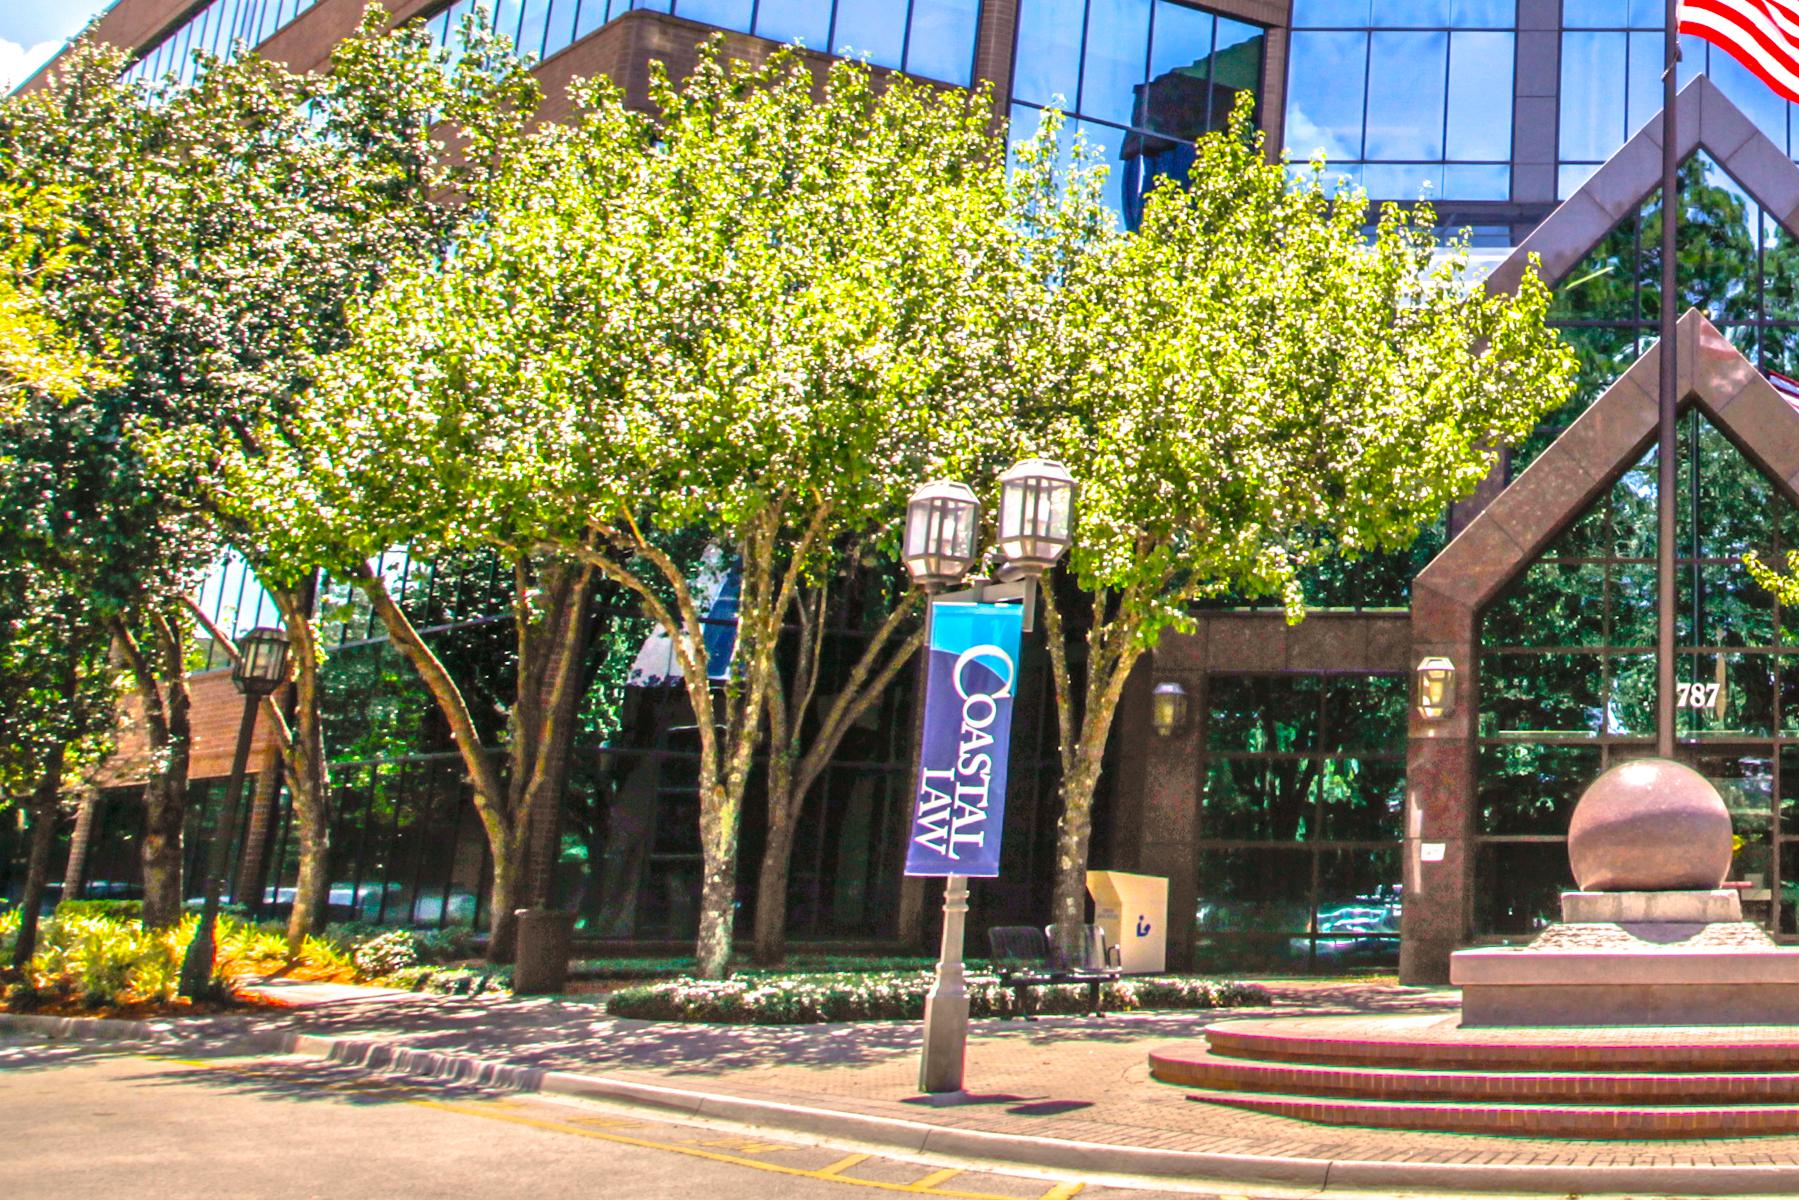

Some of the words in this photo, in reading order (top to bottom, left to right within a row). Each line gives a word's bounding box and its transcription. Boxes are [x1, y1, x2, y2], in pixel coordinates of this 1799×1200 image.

[1676, 682, 1720, 707] 787
[948, 644, 1014, 860] COASTAL
[914, 767, 954, 856] LAW
